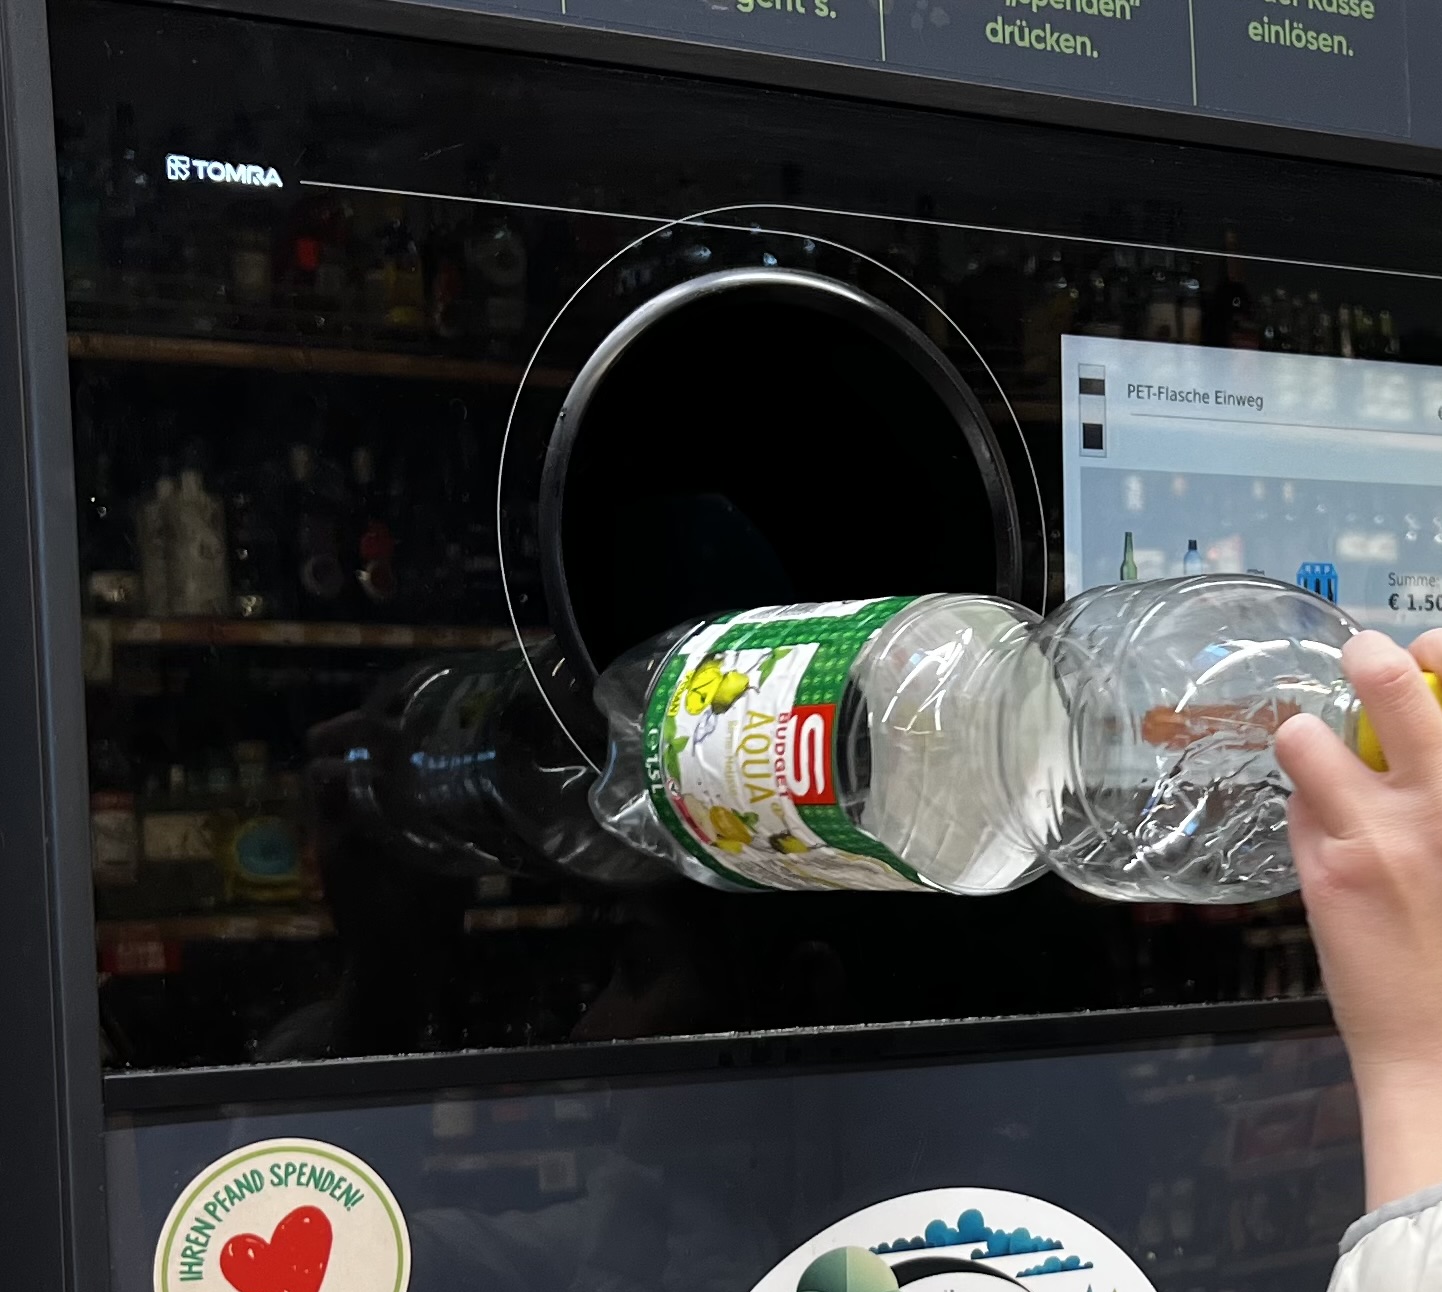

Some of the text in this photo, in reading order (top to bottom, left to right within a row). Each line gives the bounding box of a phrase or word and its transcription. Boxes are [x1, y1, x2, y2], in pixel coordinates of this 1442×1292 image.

[985, 15, 1099, 59] drücken.
[1248, 15, 1354, 57] einlösen.
[191, 158, 283, 188] TOMRA
[1127, 383, 1210, 406] PET-Flasche
[1215, 390, 1264, 412] Einweg
[1388, 572, 1440, 589] Summe:
[1388, 594, 1399, 612] €
[739, 710, 776, 804] AQUA
[179, 1161, 365, 1282] IHREN PFAND SPENDEN!
